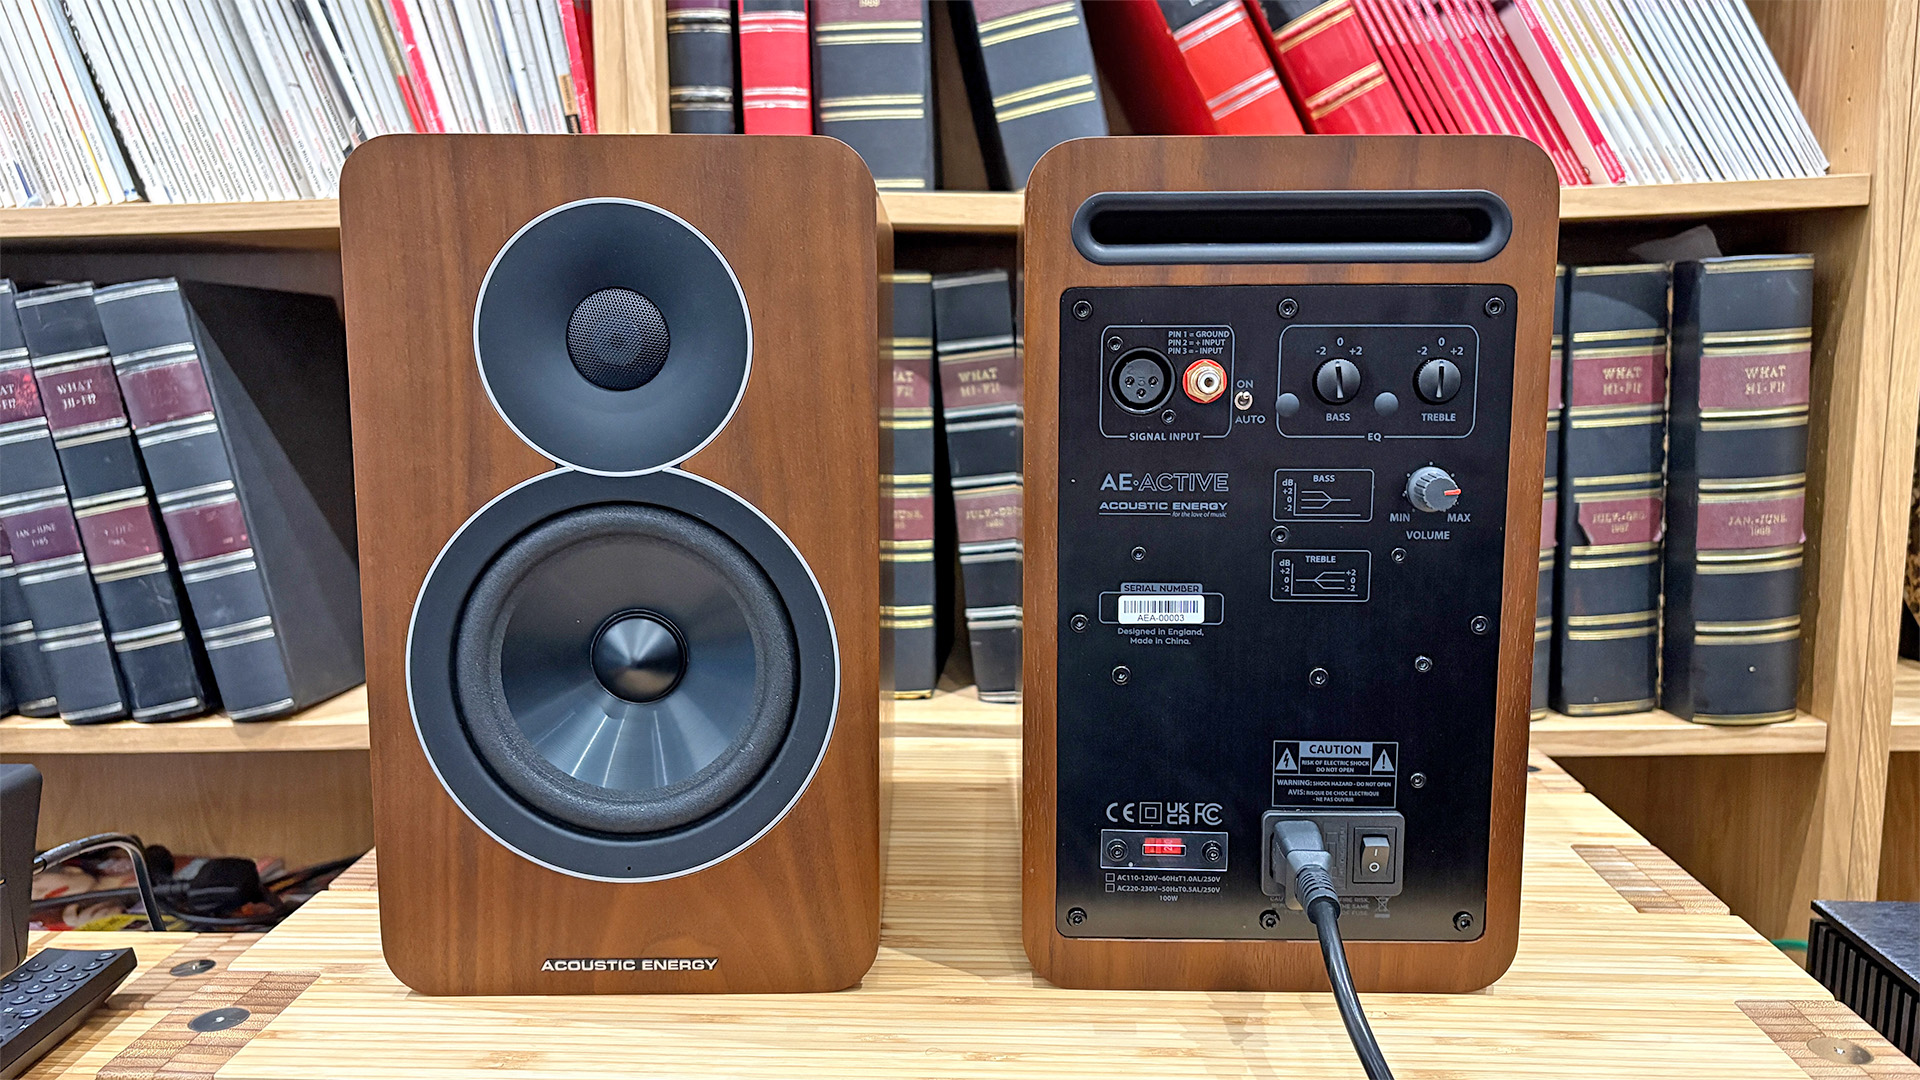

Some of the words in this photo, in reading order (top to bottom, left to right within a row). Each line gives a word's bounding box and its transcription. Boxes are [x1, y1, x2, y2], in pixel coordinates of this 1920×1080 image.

[1316, 347, 1327, 356] -2
[1336, 337, 1344, 346] 0
[1349, 347, 1363, 356] +2
[1417, 347, 1428, 356] -2
[1438, 337, 1446, 346] 0
[1450, 347, 1464, 356] +2
[893, 370, 914, 383] AT
[1602, 366, 1641, 380] WHAT
[1744, 364, 1786, 380] WHAT
[56, 379, 93, 395] WHAT
[1236, 380, 1254, 389] ON
[0, 384, 15, 396] AT
[1235, 415, 1266, 424] AUTO
[1326, 413, 1351, 422] BASS
[1421, 413, 1456, 422] TREBLE
[1129, 432, 1167, 441] SIGNAL
[1169, 432, 1200, 441] INPUT
[1367, 433, 1382, 442] EQ
[1313, 474, 1335, 483] BASS
[1099, 502, 1168, 511] ACOUSTIC
[1172, 502, 1228, 511] ENERGY
[1389, 513, 1410, 522] MIN
[1447, 513, 1471, 522] MAX
[1406, 530, 1450, 540] VOLUME
[1279, 559, 1291, 567] dB
[1305, 555, 1336, 563] TREBLE
[1280, 567, 1290, 575] +2
[1124, 584, 1157, 592] SERIAL
[1160, 584, 1200, 593] NUMBER
[1137, 614, 1185, 622] AEA-00003
[1118, 627, 1156, 636] Designed
[1168, 628, 1204, 637] England,
[1130, 637, 1153, 645] Made
[1155, 637, 1163, 645] in
[1165, 637, 1191, 645] China.
[1309, 744, 1362, 755] CAUTION
[1105, 802, 1135, 823] CE
[1166, 802, 1190, 814] UK
[1166, 814, 1190, 825] CA
[541, 959, 636, 972] ACOUSTIC
[641, 958, 719, 971] ENERGY
